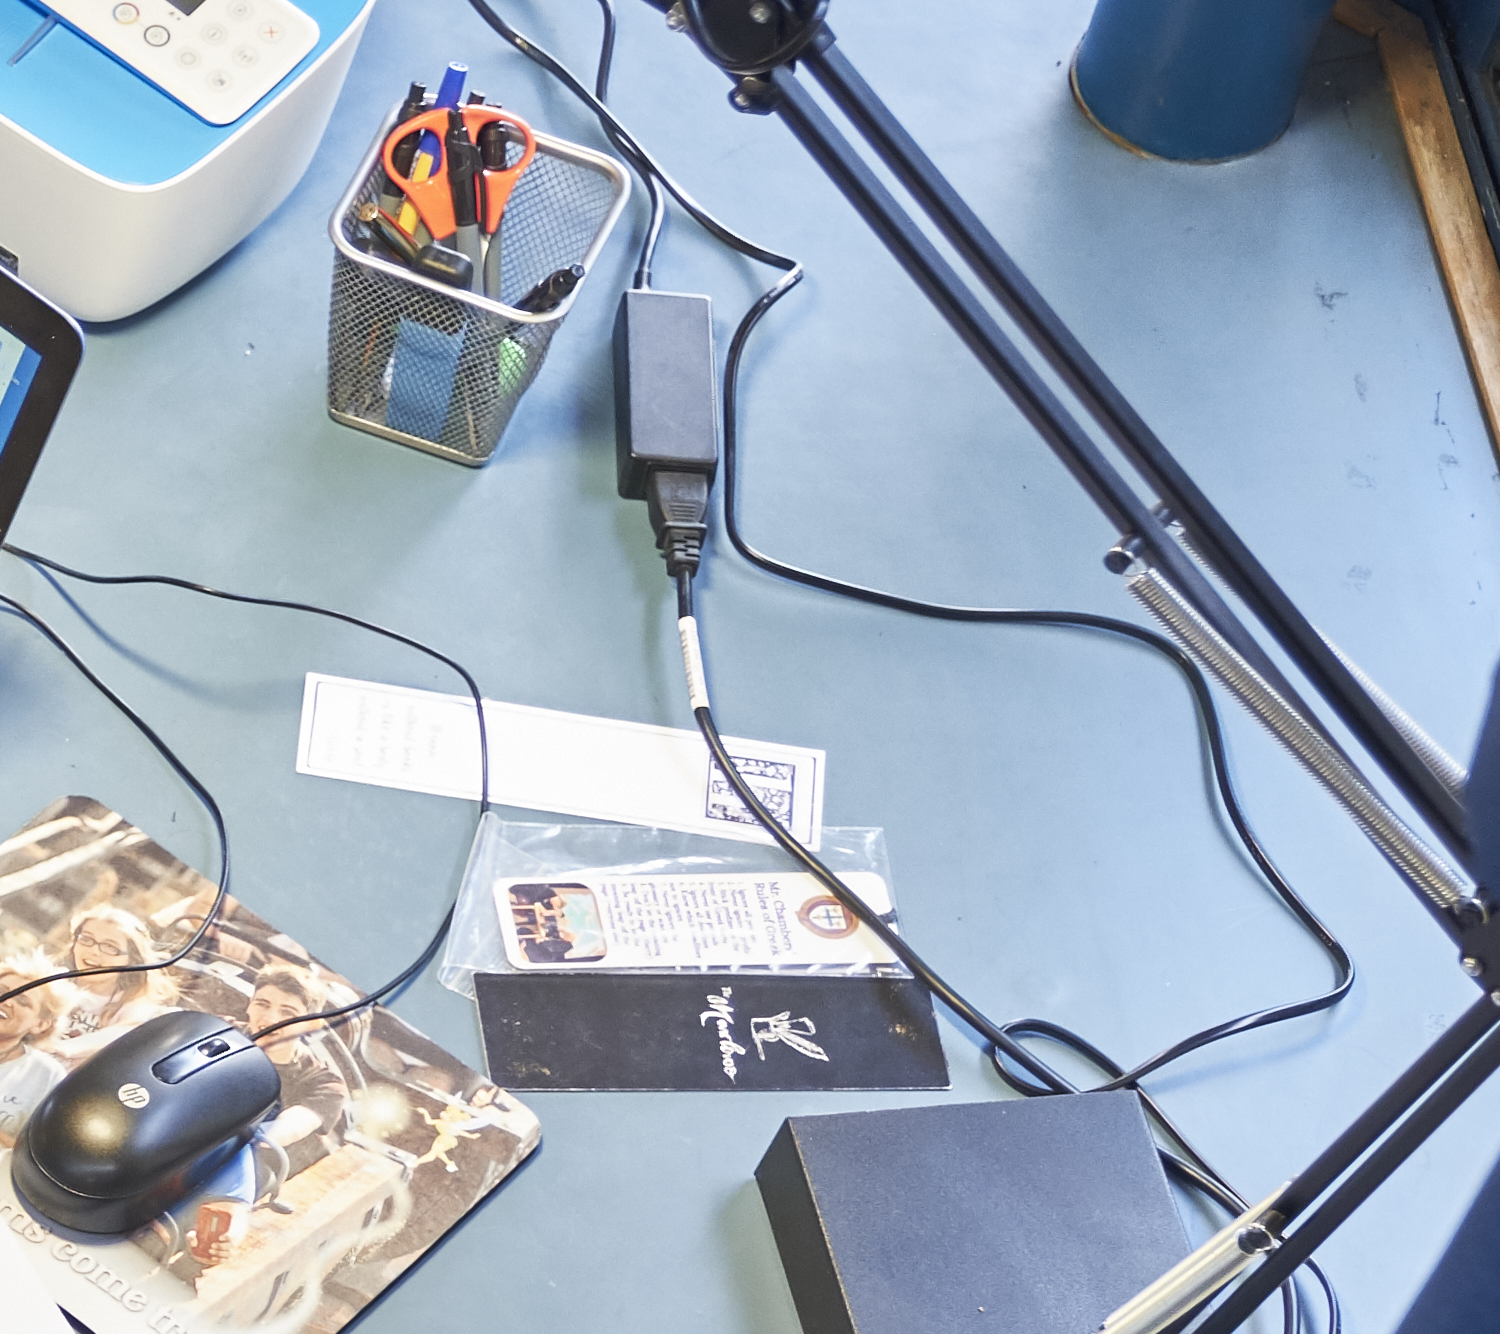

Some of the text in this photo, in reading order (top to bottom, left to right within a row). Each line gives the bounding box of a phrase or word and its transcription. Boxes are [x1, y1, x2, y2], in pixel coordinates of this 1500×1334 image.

[753, 882, 781, 956] Rules of Greek
[118, 1083, 150, 1109] hp
[50, 1234, 150, 1313] come
